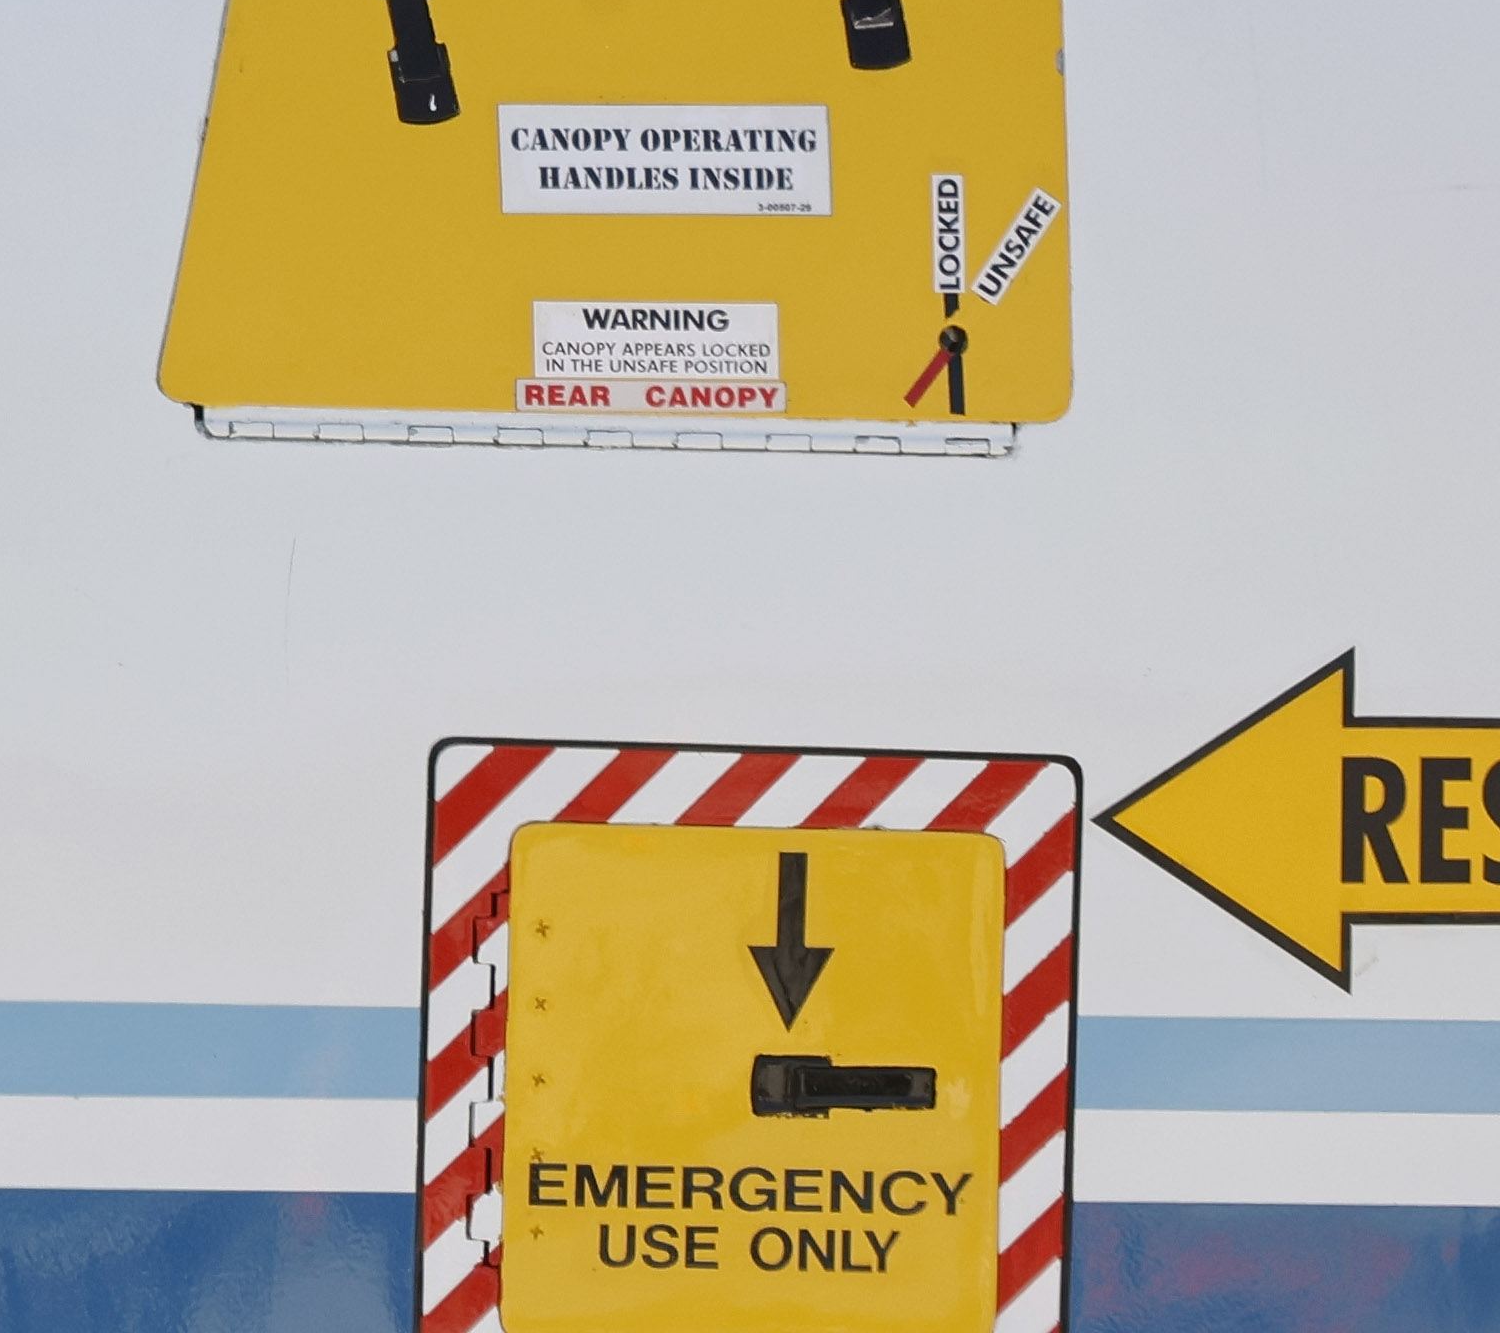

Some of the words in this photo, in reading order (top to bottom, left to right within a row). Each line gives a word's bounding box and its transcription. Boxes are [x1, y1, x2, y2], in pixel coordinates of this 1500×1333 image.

[510, 127, 631, 151] CANOPY
[640, 128, 818, 153] OPERATING
[539, 166, 679, 190] HANDLES
[689, 167, 794, 191] INSIDE
[938, 178, 960, 290] LOCKED
[978, 196, 1055, 296] UNSAFE
[582, 308, 730, 331] WARNING
[542, 341, 617, 356] CANOPY
[622, 343, 696, 357] APPEARS
[702, 344, 771, 357] LOCKED
[546, 358, 565, 373] IN
[571, 358, 604, 373] THE
[609, 359, 679, 374] UNSAFE
[684, 360, 768, 374] POSITION
[524, 384, 611, 407] REAR
[645, 386, 779, 408] CANOPY
[527, 1162, 974, 1216] EMERGENCY
[598, 1223, 720, 1271] USE
[749, 1226, 901, 1274] ONLY
